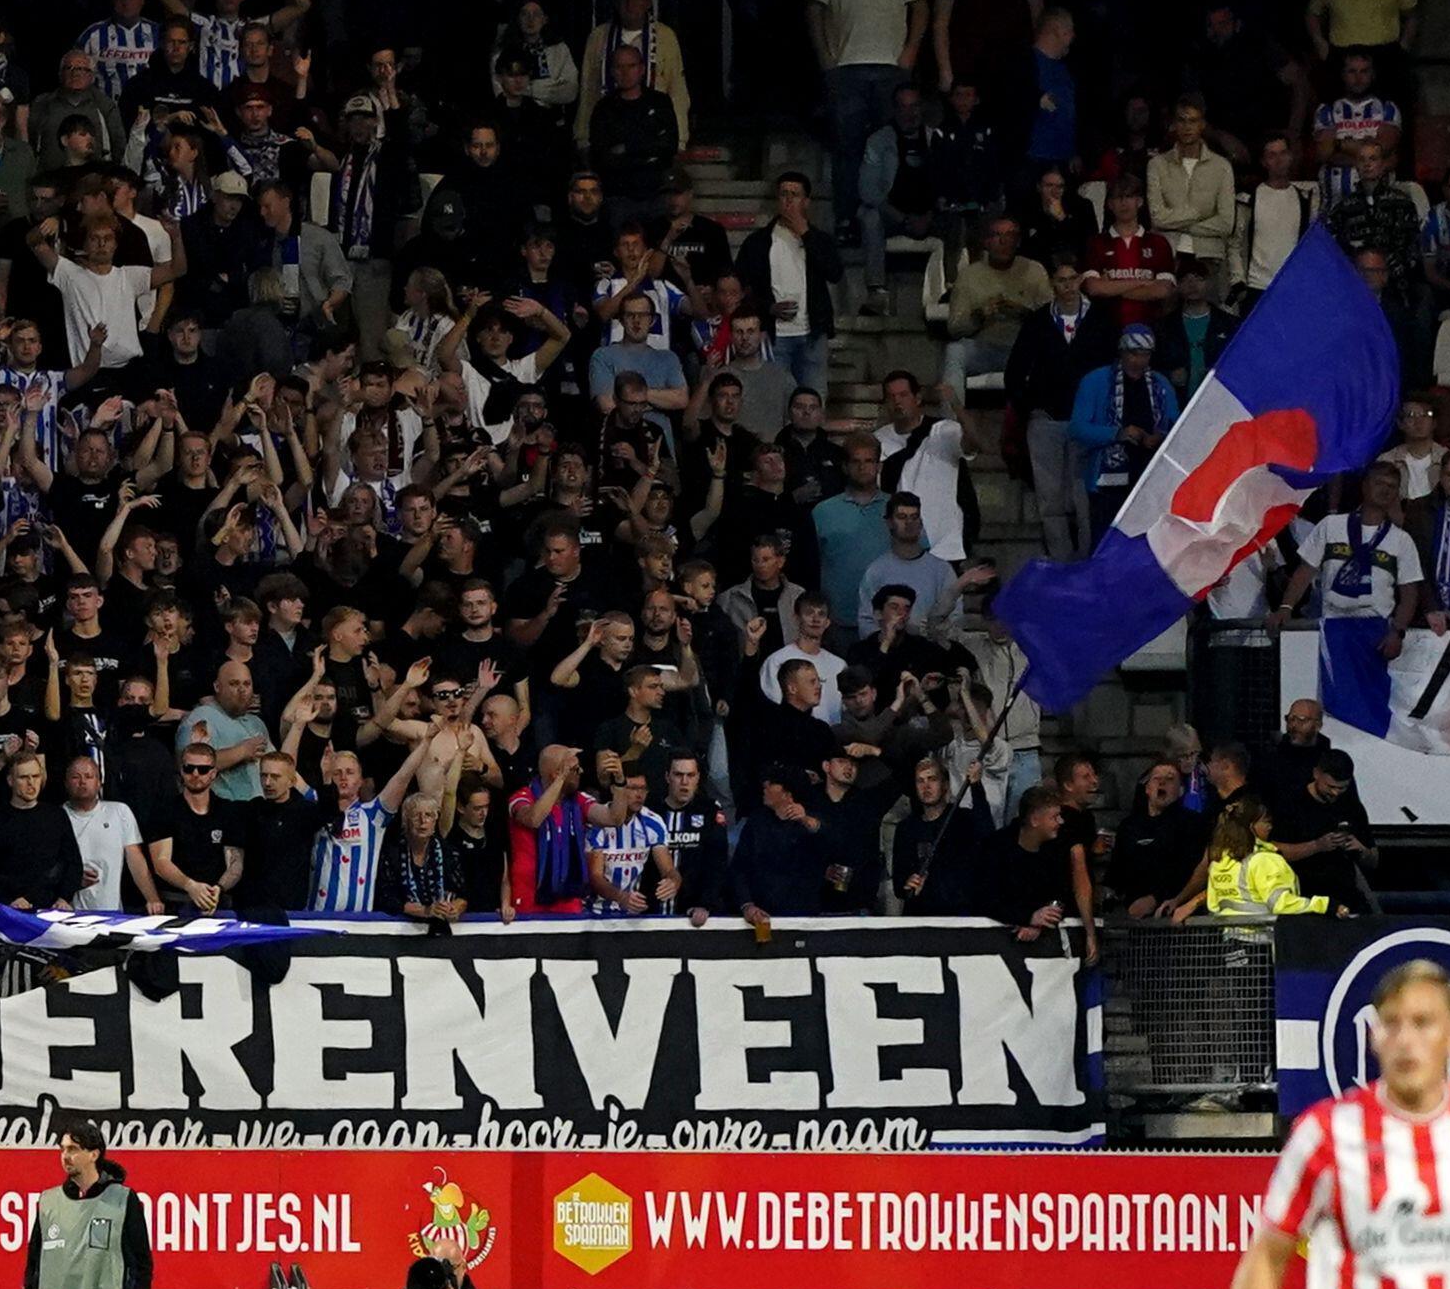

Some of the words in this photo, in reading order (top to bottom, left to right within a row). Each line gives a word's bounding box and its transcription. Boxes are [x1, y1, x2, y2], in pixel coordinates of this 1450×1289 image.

[667, 831, 701, 845] LKOM
[557, 1200, 630, 1224] BETROKKEN
[645, 1190, 1263, 1253] WWW.DEBETROKKENSPARTAAN.N
[564, 1224, 630, 1246] SPARTAAN
